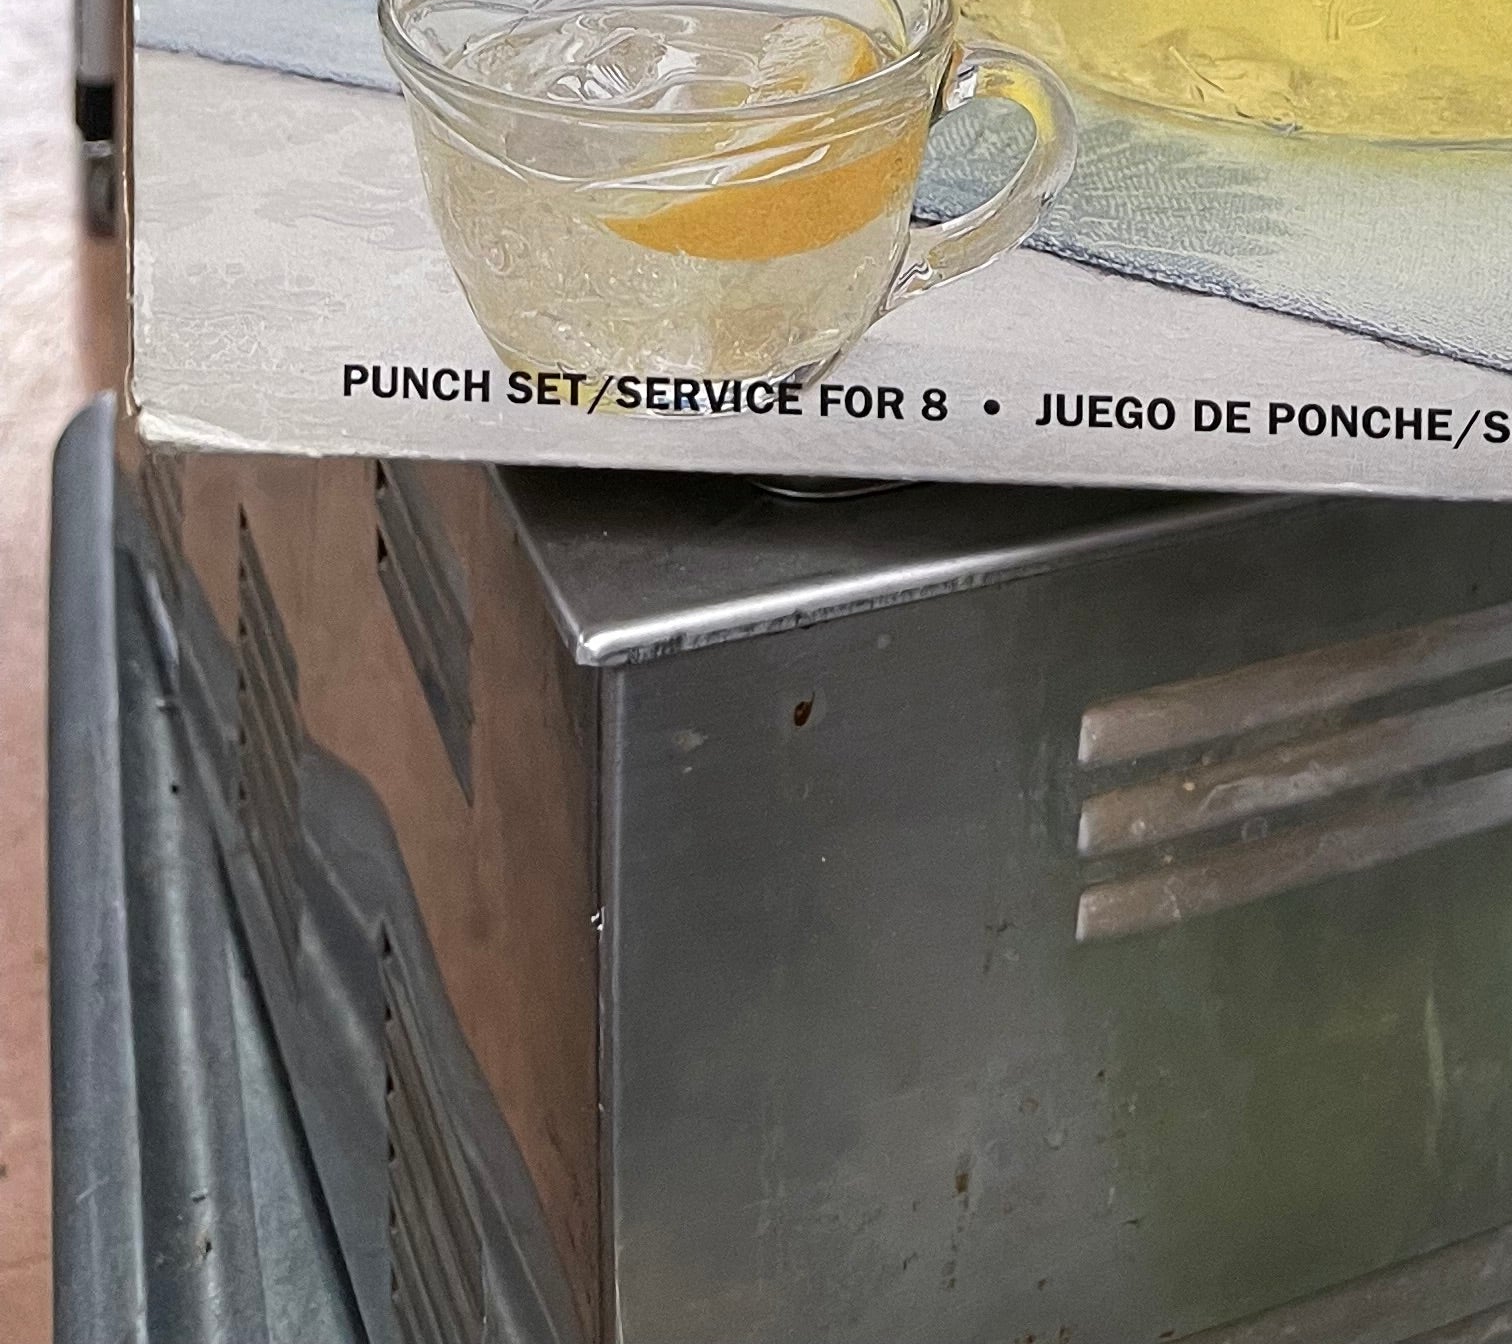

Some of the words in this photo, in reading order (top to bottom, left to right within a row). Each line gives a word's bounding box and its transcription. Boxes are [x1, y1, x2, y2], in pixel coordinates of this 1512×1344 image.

[343, 364, 490, 403] PUNCH
[506, 370, 803, 416] SET/SERVICE
[820, 383, 904, 420] FOR
[921, 388, 948, 422] 8
[1035, 393, 1176, 431] JUEGO
[1195, 399, 1252, 434] DE
